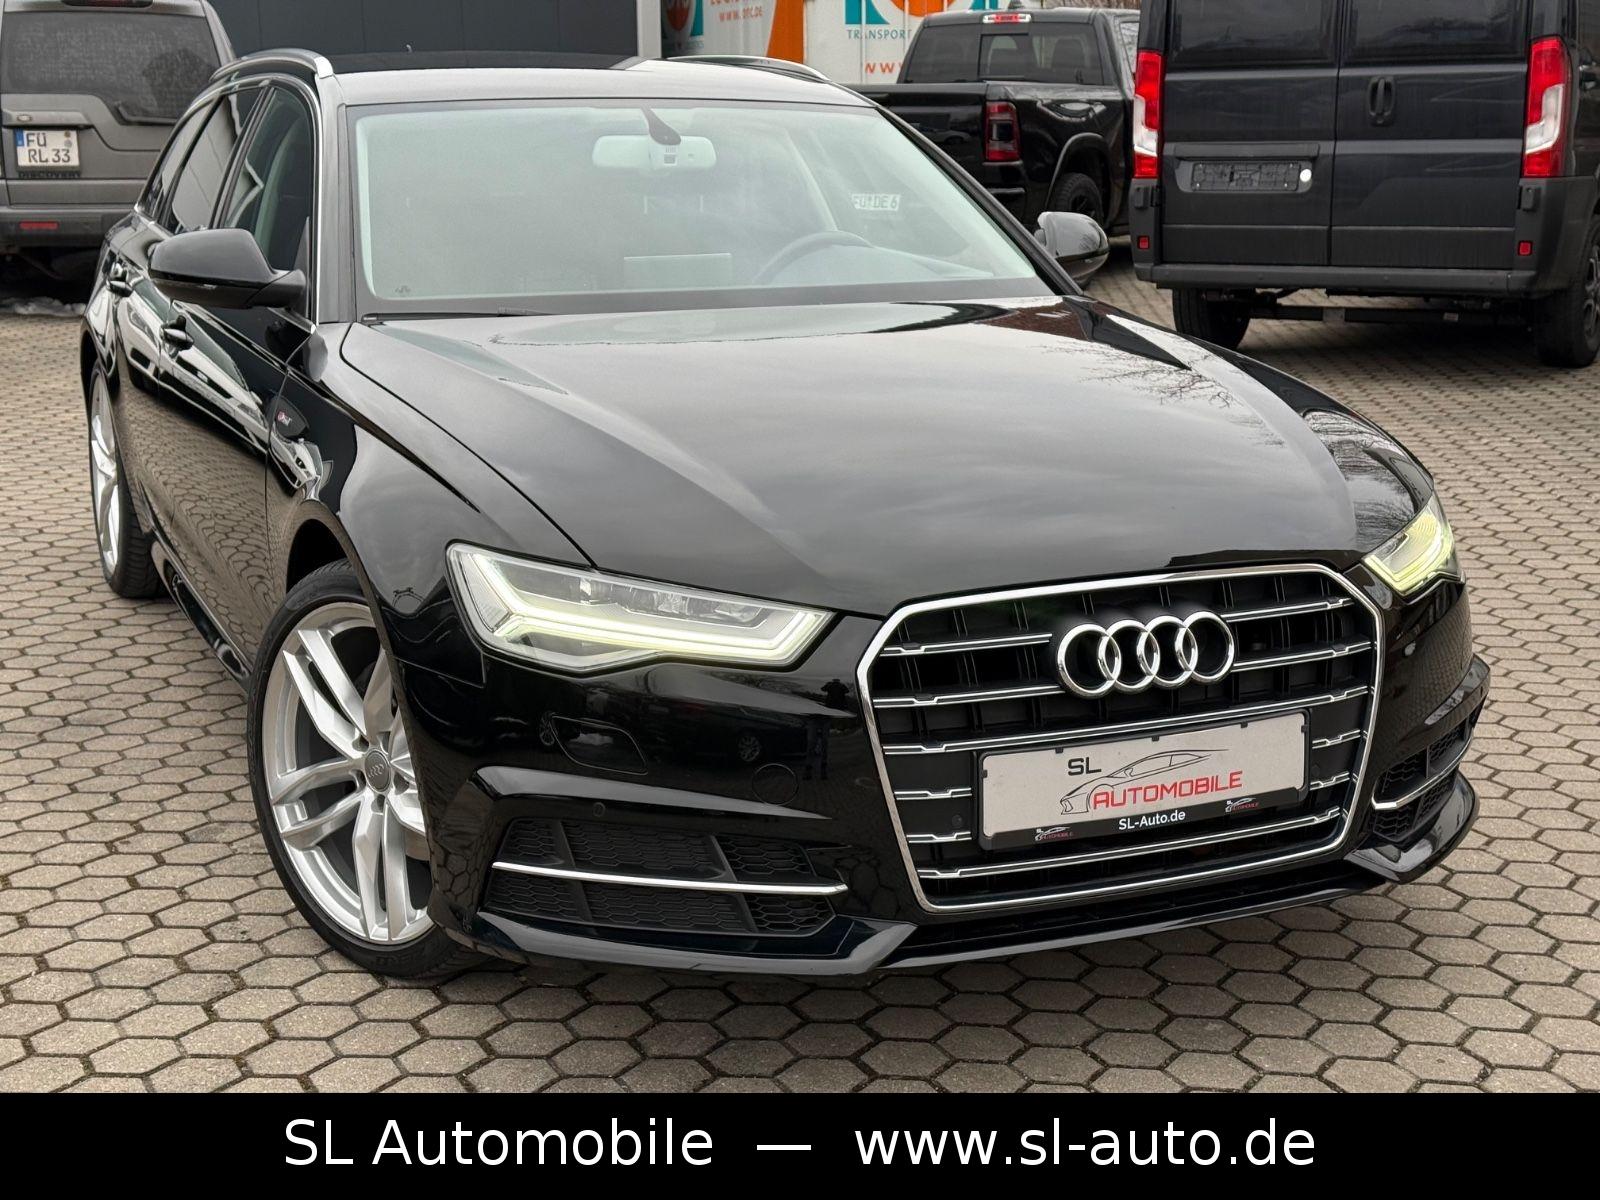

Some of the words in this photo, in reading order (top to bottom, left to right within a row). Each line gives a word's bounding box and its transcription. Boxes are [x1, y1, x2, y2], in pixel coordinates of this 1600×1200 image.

[26, 132, 47, 147] FÜ
[28, 149, 48, 163] RL
[52, 149, 71, 163] 33
[1067, 757, 1102, 776] SL
[1093, 770, 1243, 810] AUTOMOBILE
[1118, 809, 1186, 831] SL-Auto.de
